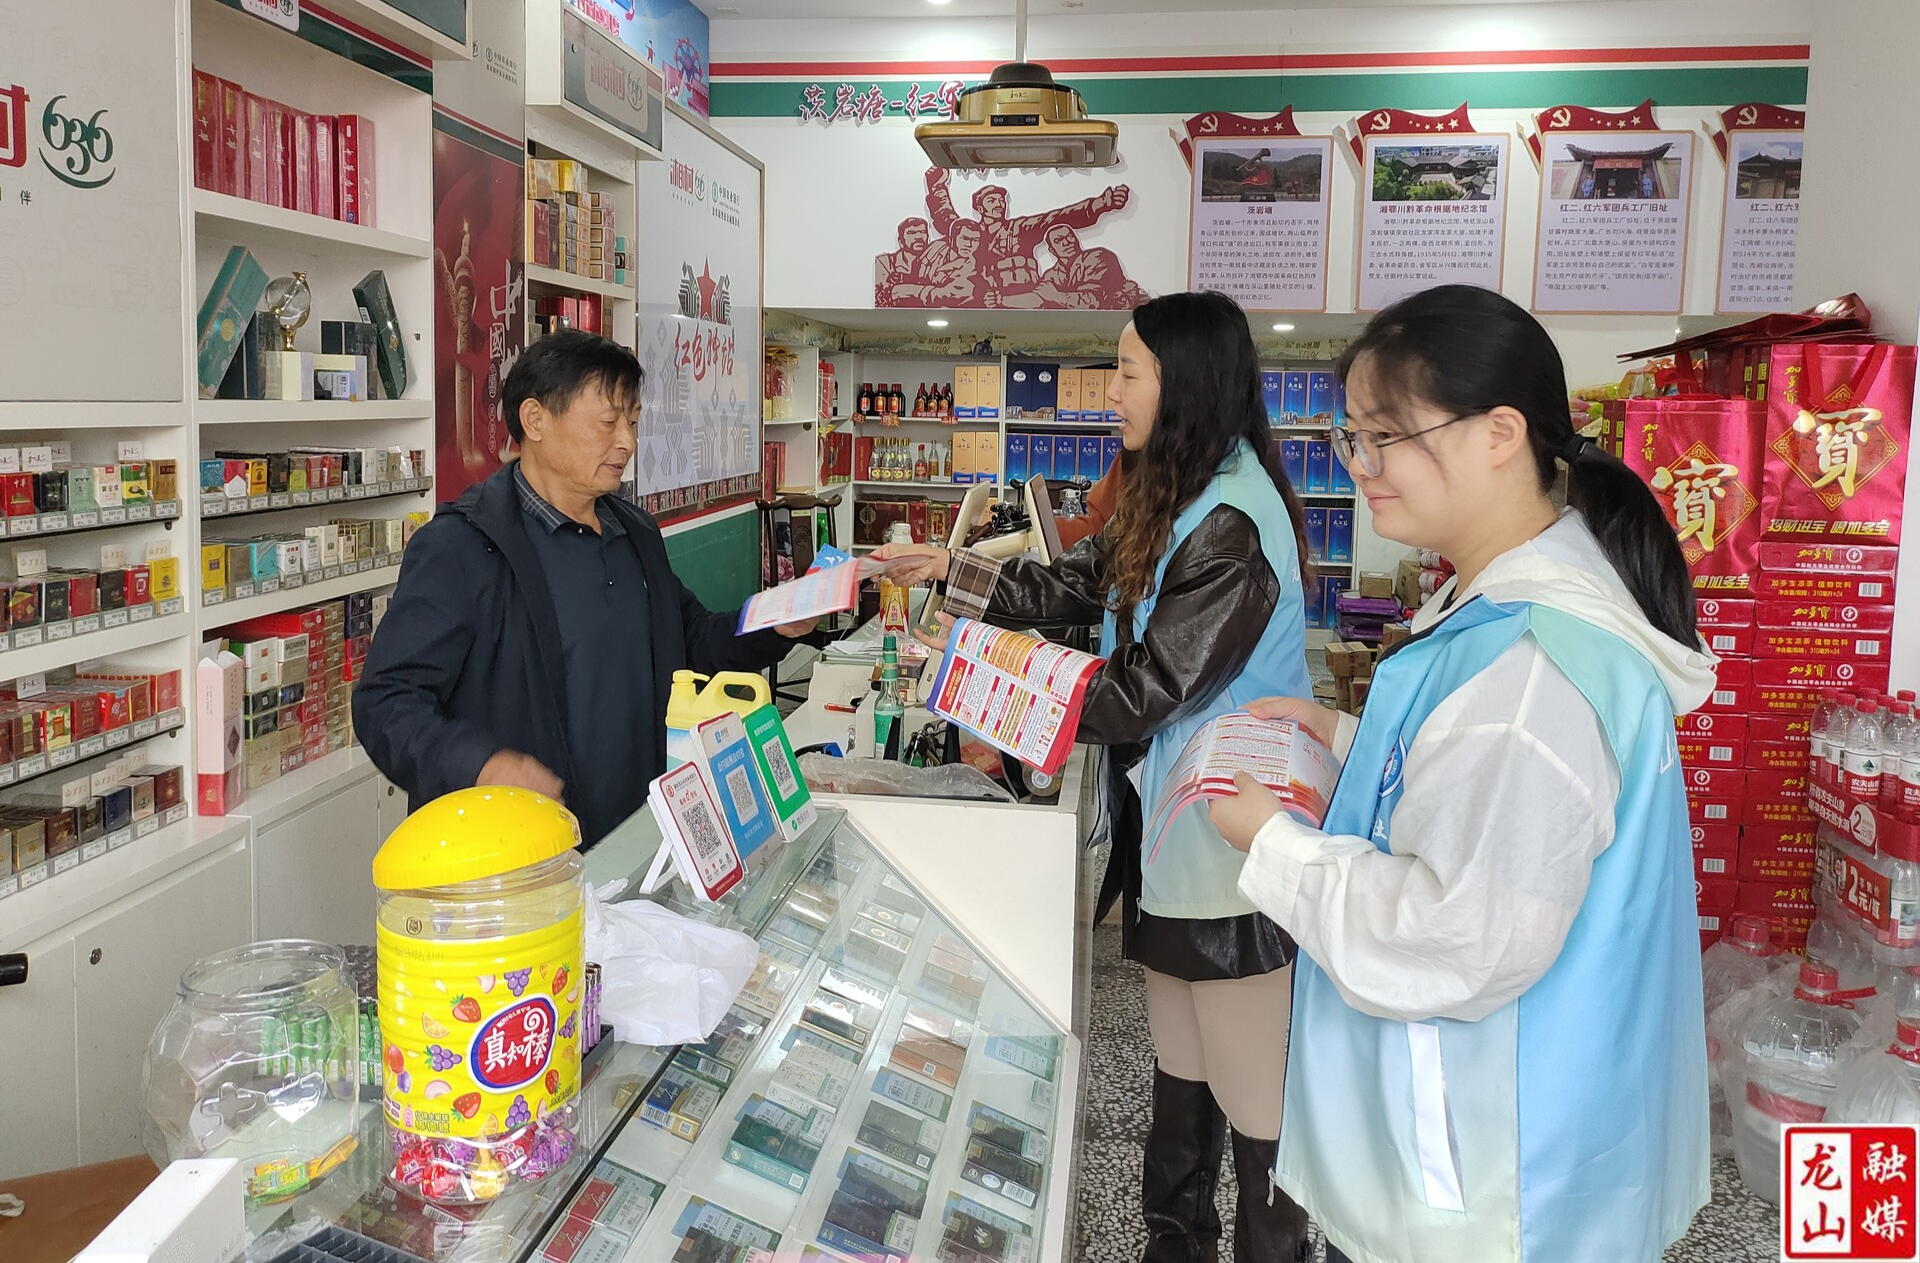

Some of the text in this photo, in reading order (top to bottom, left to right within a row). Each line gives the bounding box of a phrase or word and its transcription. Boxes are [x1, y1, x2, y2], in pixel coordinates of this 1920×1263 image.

[1246, 205, 1274, 215] 茨岩塘
[1379, 204, 1488, 214] 湘鄂川黔革命根据地纪念馆
[1559, 203, 1668, 212] 红二、红六军团兵工厂旧址
[674, 321, 735, 390] 红色驿站
[1767, 518, 1892, 536] 招财进宝 喝加多宝
[1692, 573, 1751, 589] 喝加多宝
[1770, 579, 1852, 589] 加多宝凉茶 植物饮料
[1768, 637, 1849, 647] 加多宝凉茶 植物饮料
[1761, 692, 1804, 701] 加多宝凉茶
[1848, 865, 1858, 905] 2
[496, 1006, 532, 1027] WRIGLEY'S
[483, 1025, 552, 1073] 真知棒
